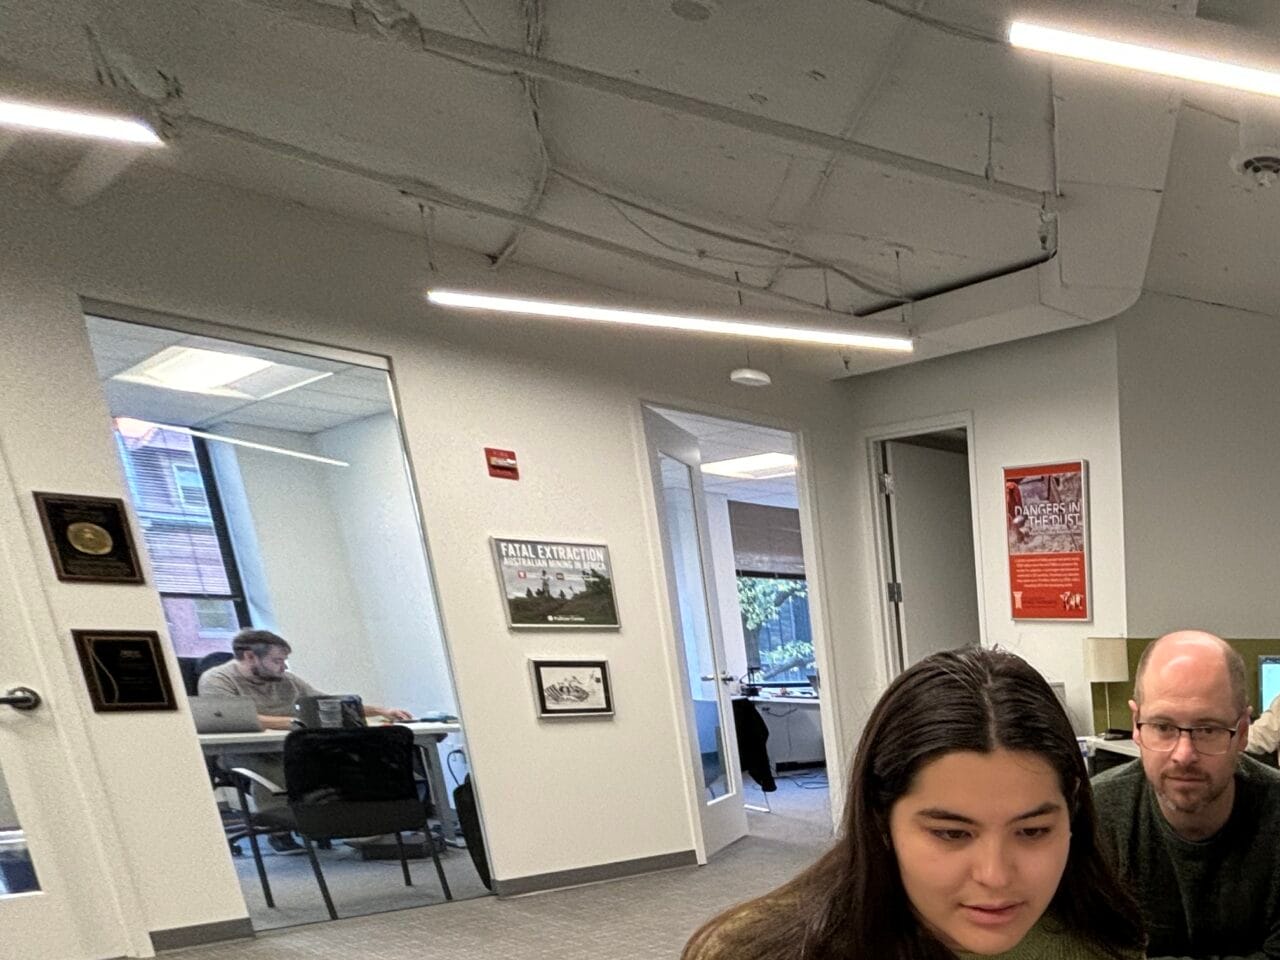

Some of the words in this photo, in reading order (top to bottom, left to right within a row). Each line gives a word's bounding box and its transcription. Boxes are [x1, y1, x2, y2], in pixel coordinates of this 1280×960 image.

[1015, 503, 1066, 517] DANGERS
[1069, 502, 1080, 513] IN
[1028, 515, 1048, 529] THE
[1051, 513, 1080, 527] DUST
[500, 542, 536, 558] FATAL
[537, 545, 605, 562] EXTRACTION
